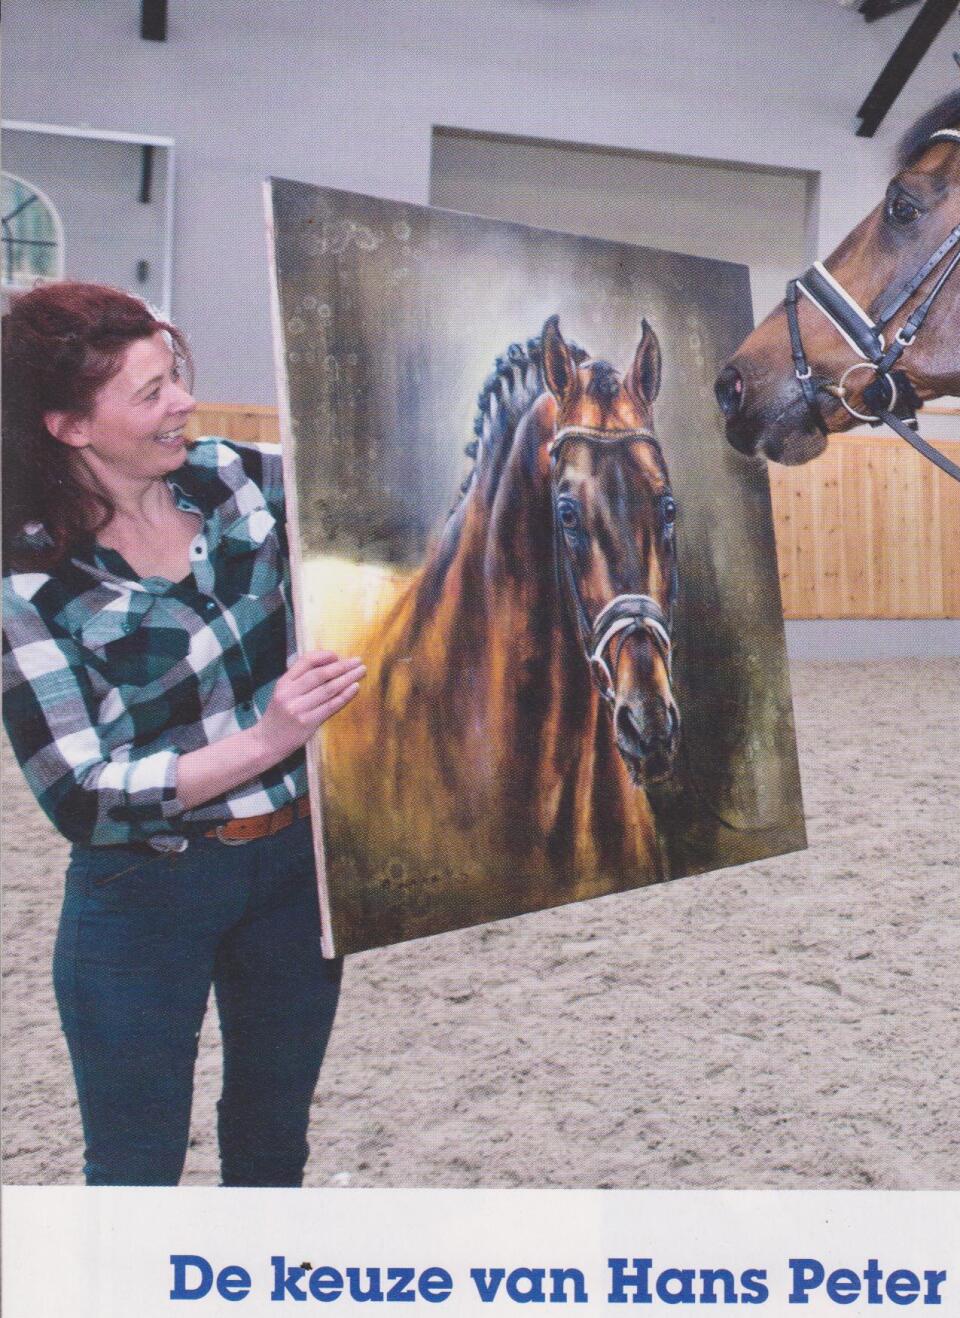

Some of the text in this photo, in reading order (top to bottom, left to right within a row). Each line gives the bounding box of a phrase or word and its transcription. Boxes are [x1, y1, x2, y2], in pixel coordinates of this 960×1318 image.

[170, 1255, 947, 1305] De keuze van Hans Peter
